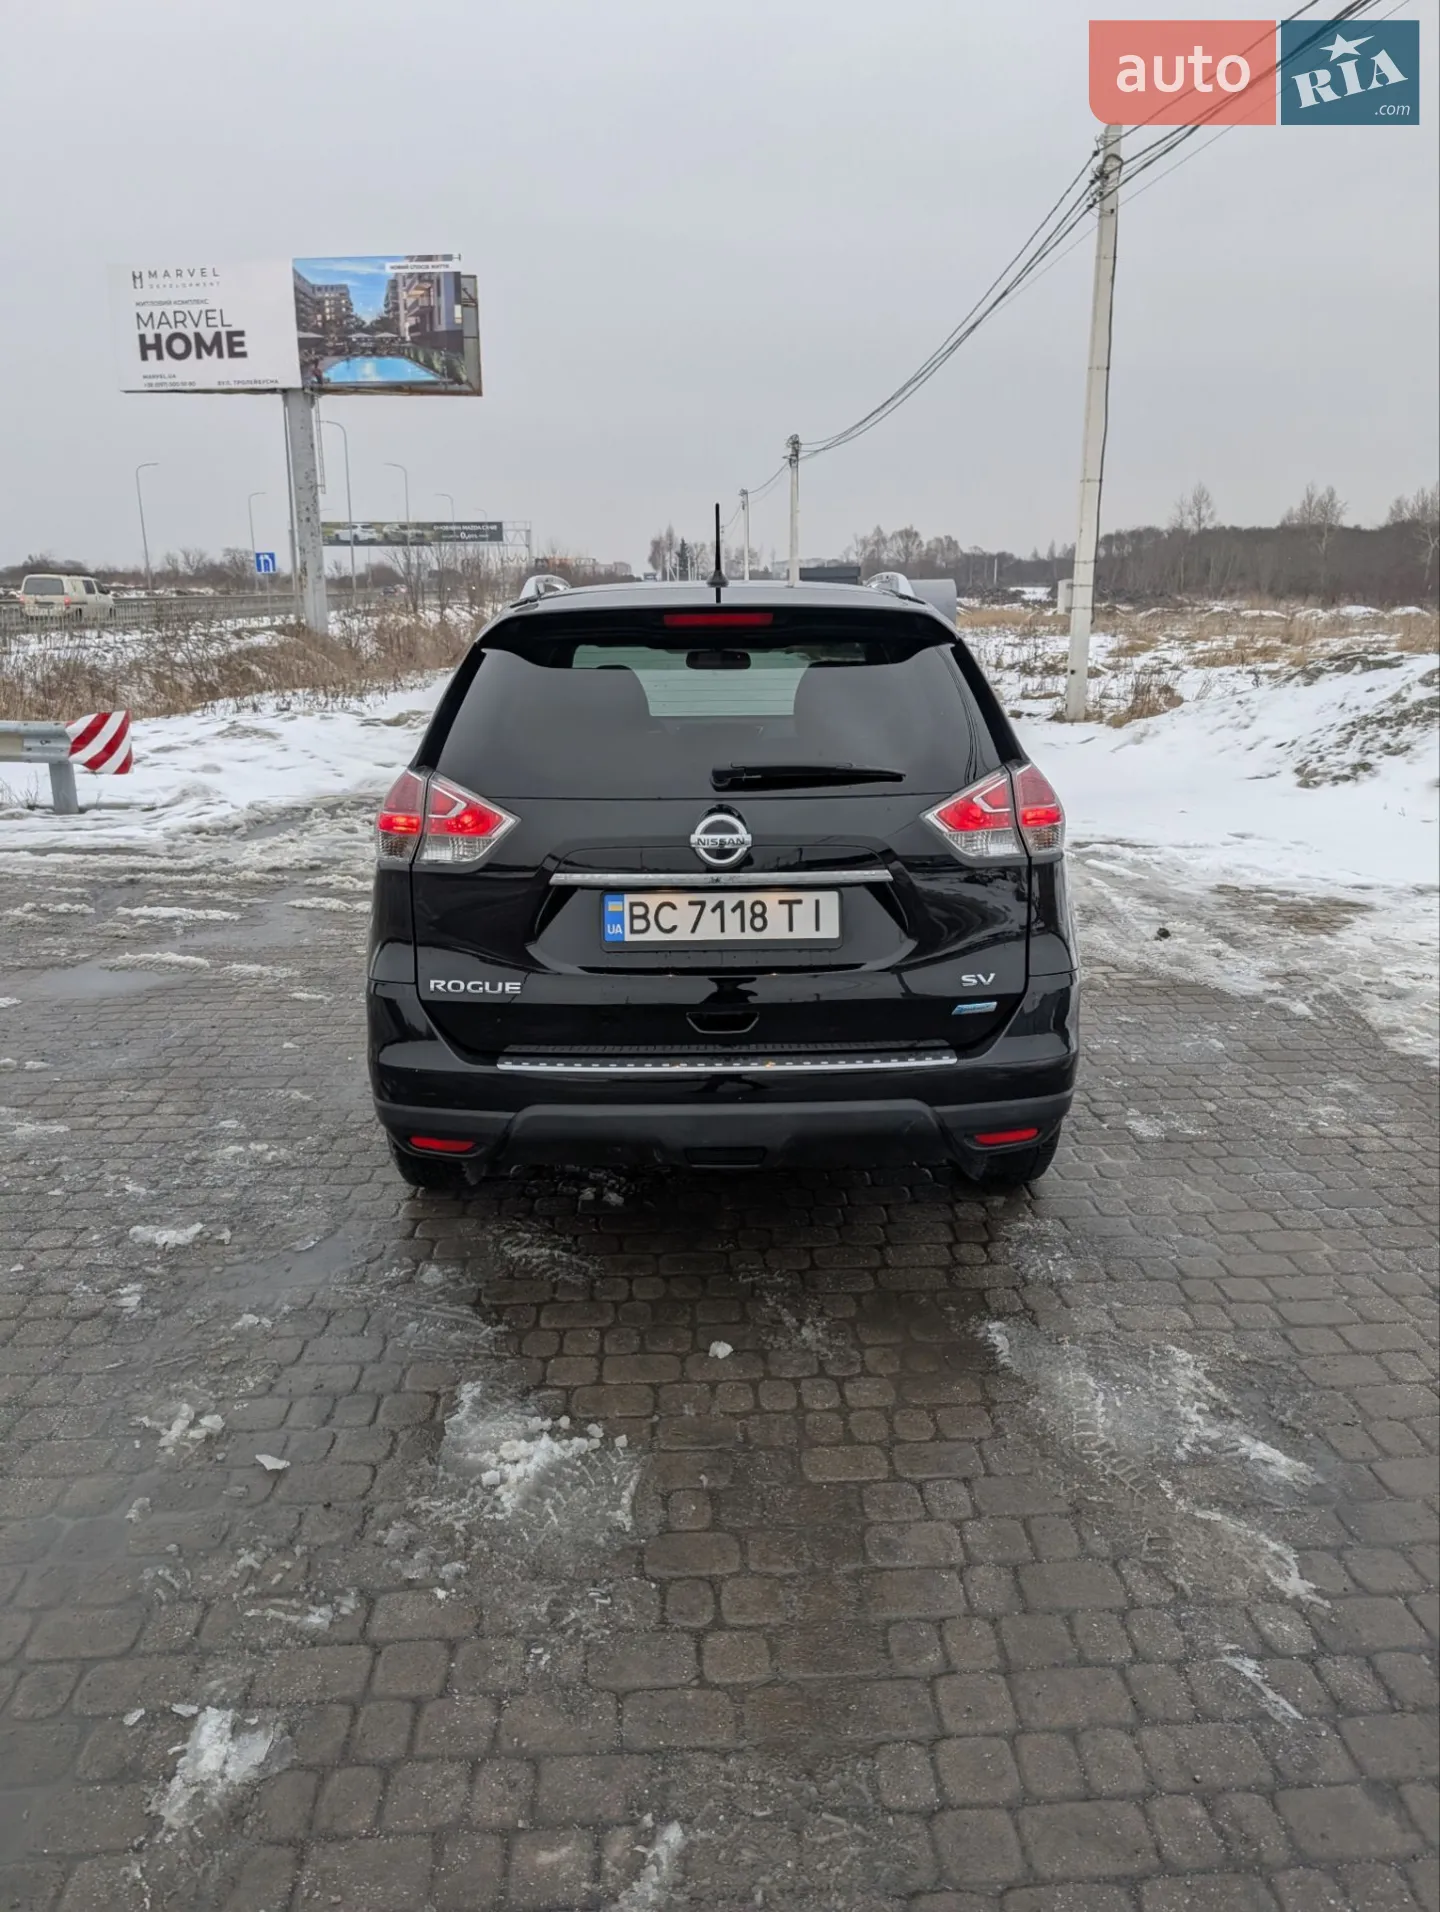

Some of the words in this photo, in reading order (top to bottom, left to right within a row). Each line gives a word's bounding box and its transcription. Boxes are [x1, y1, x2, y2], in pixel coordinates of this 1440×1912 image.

[147, 267, 221, 280] MARVEL
[135, 308, 233, 330] MARVEL
[137, 330, 249, 362] HOME
[696, 837, 746, 847] NISSAN
[629, 900, 678, 935] BC
[687, 899, 768, 935] 7118
[607, 923, 623, 935] UA
[429, 979, 522, 994] ROGUE
[961, 972, 996, 987] SV
